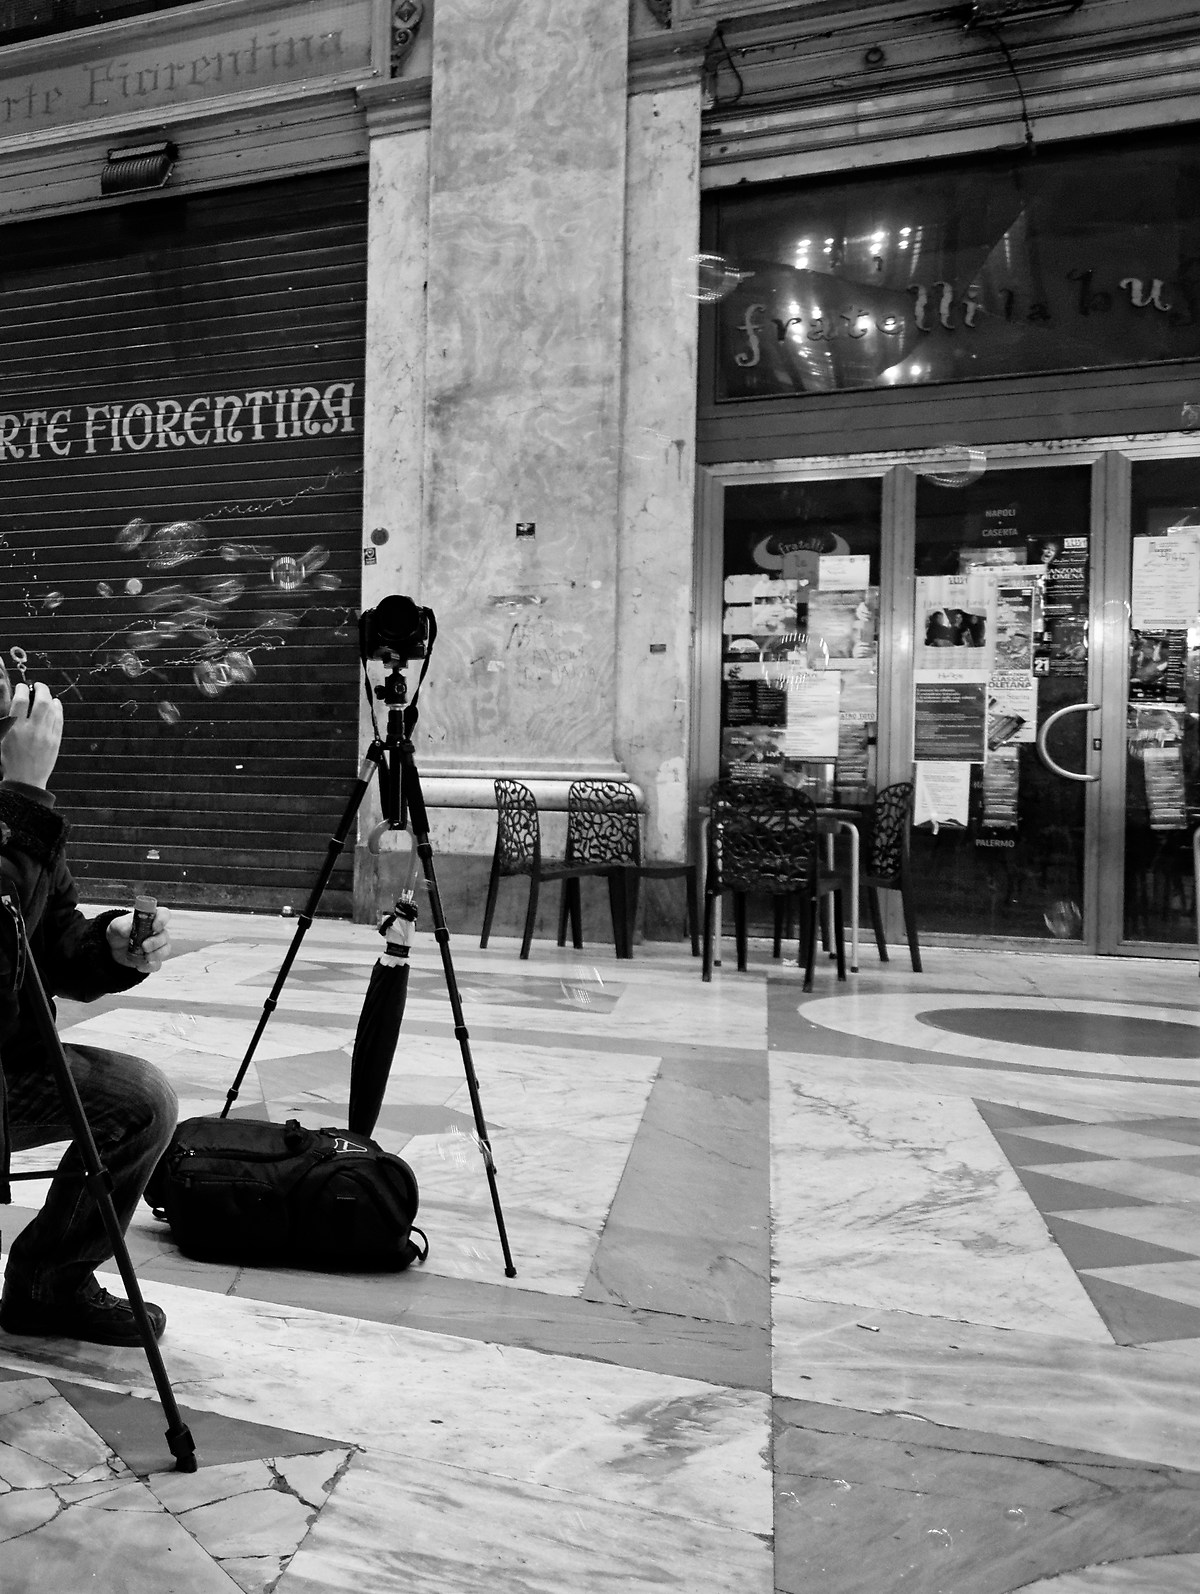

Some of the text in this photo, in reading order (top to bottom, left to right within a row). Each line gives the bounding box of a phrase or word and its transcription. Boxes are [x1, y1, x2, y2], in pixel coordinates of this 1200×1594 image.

[80, 26, 346, 109] Fiorentina
[85, 382, 356, 454] FIORENTINA
[985, 508, 1017, 518] NAPOLI
[981, 527, 1019, 537] CASERTA
[1034, 659, 1050, 671] 21
[975, 839, 1016, 848] PALERMO
